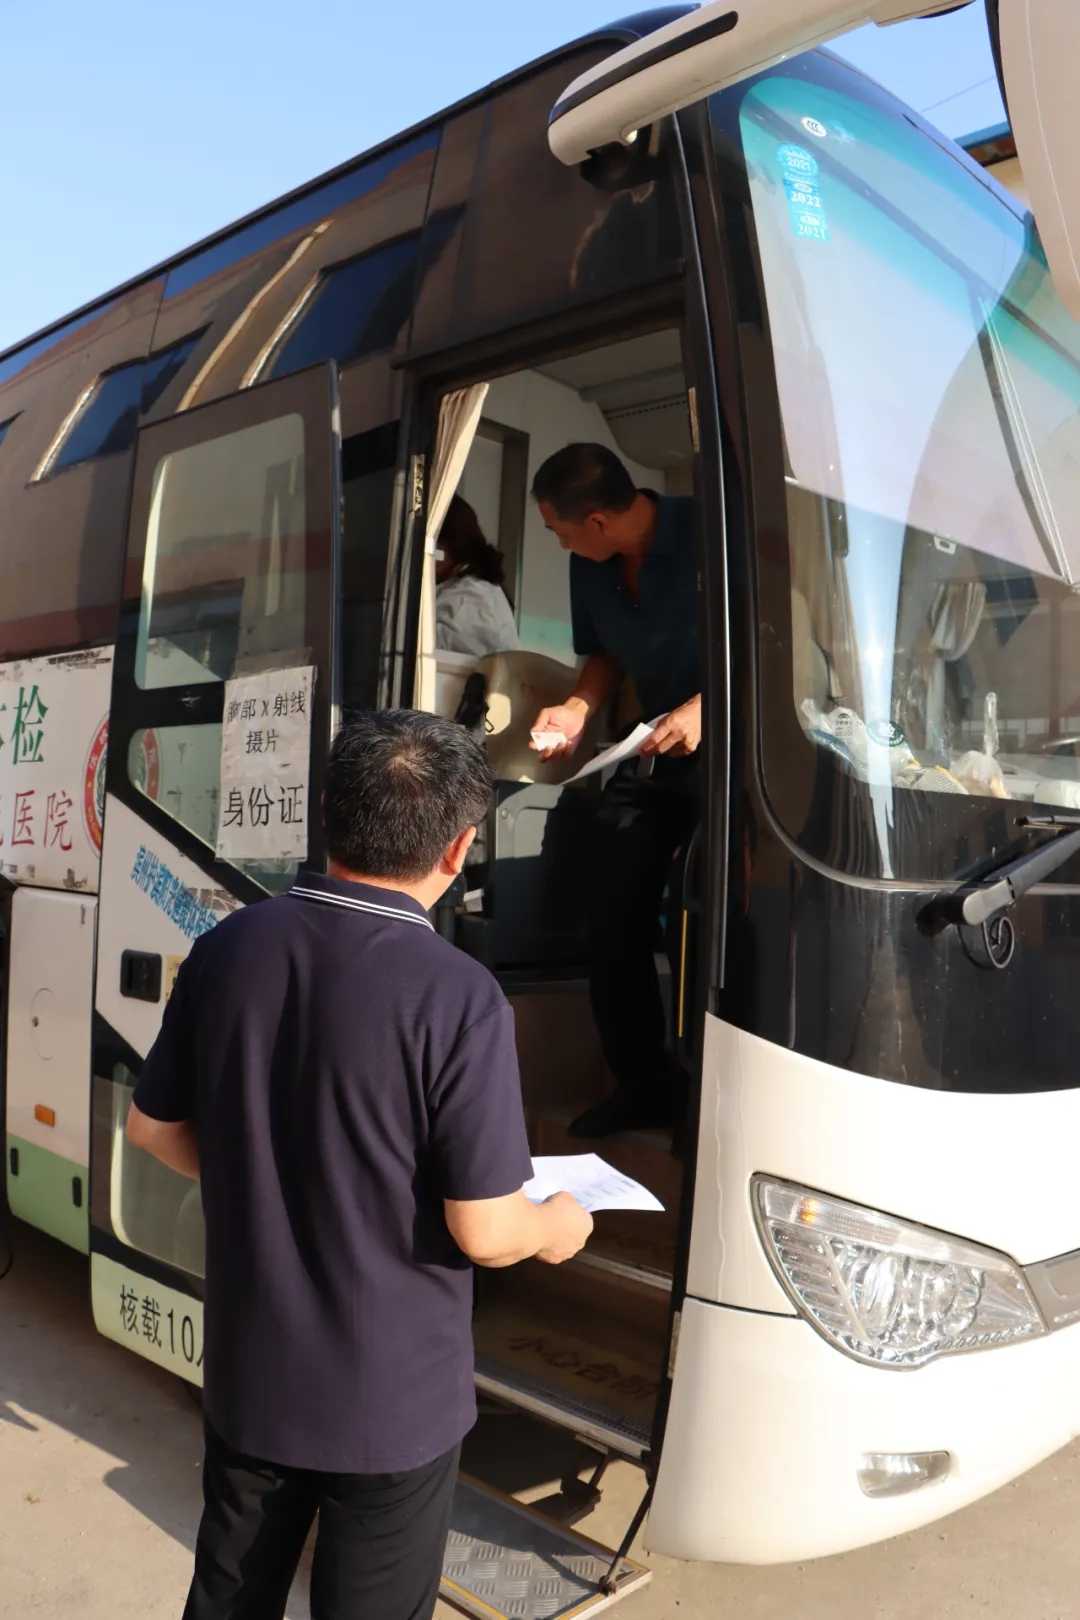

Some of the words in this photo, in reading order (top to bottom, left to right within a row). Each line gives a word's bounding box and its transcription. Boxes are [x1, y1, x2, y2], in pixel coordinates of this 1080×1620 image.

[0, 684, 48, 765] 检
[245, 727, 279, 754] 摄片
[0, 789, 73, 851] 医院
[223, 784, 304, 828] 身份证
